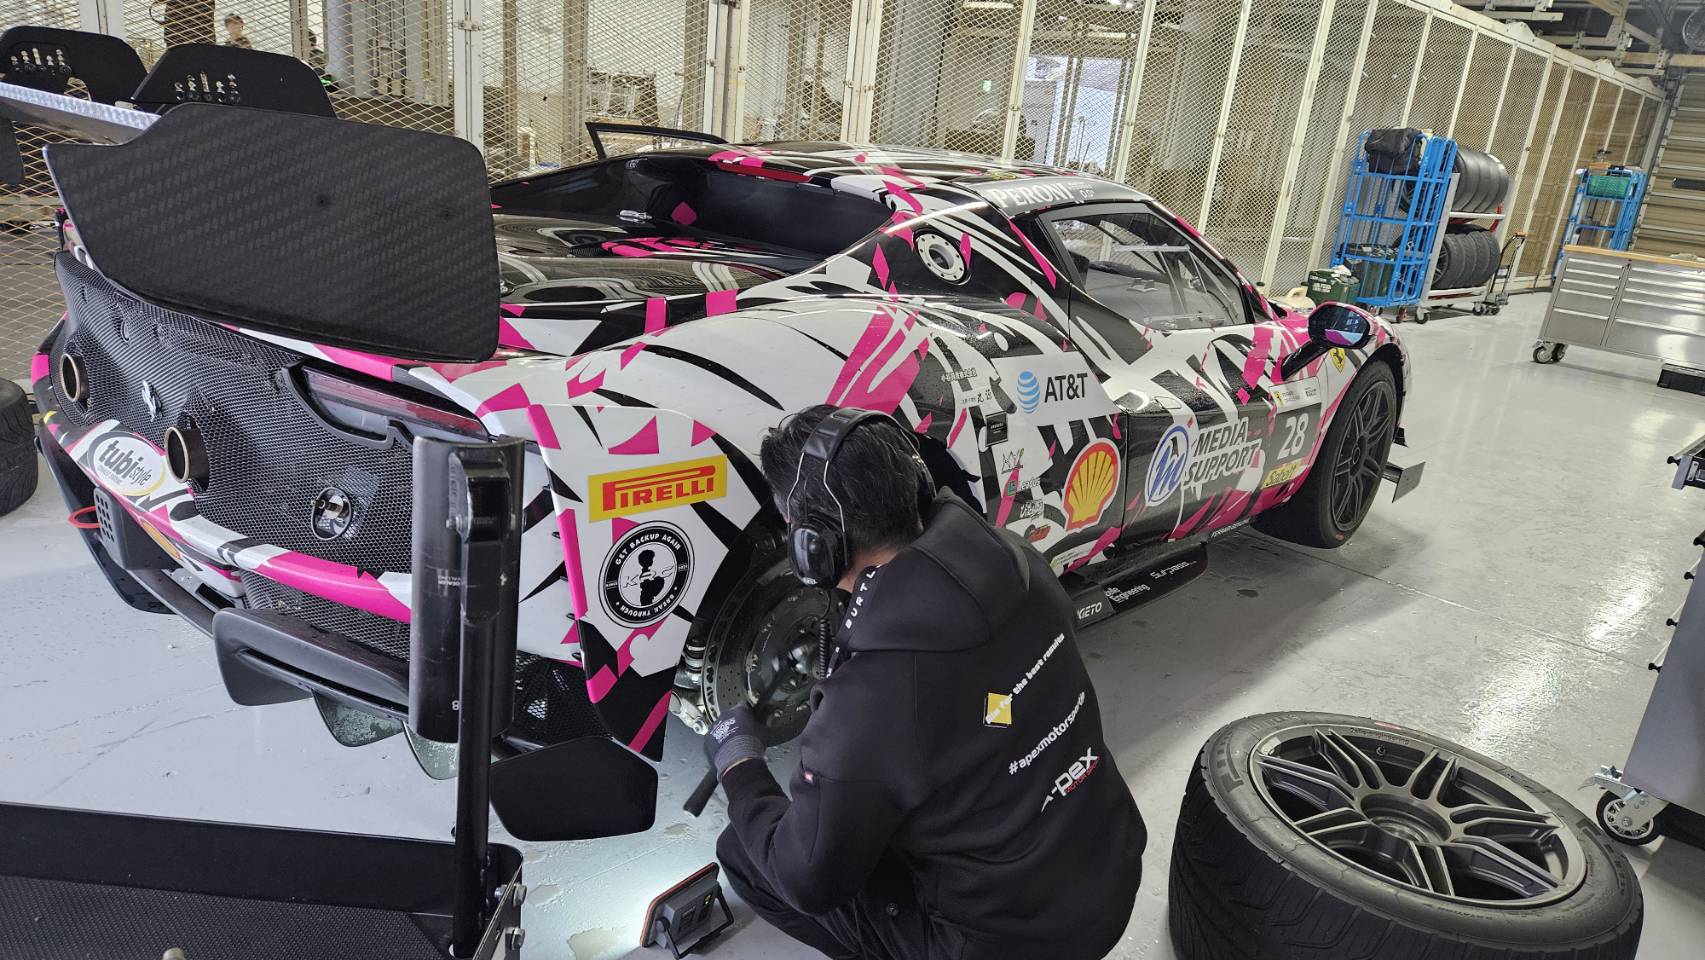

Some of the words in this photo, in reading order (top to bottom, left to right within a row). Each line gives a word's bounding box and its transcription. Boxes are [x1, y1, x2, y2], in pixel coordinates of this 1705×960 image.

[988, 183, 1074, 208] PERONI
[1044, 373, 1088, 403] AT&T
[1193, 417, 1248, 457] MEDIA
[1277, 413, 1309, 460] 28
[99, 440, 144, 479] tubi
[129, 465, 152, 486] style
[1183, 442, 1261, 487] SUPPORT
[602, 465, 716, 512] PIRELLI
[615, 548, 628, 565] GET
[629, 533, 660, 549] BACKUP
[662, 534, 682, 550] AGAIN
[845, 564, 882, 630] BURTL
[1013, 678, 1028, 695] the
[1026, 659, 1043, 680] best
